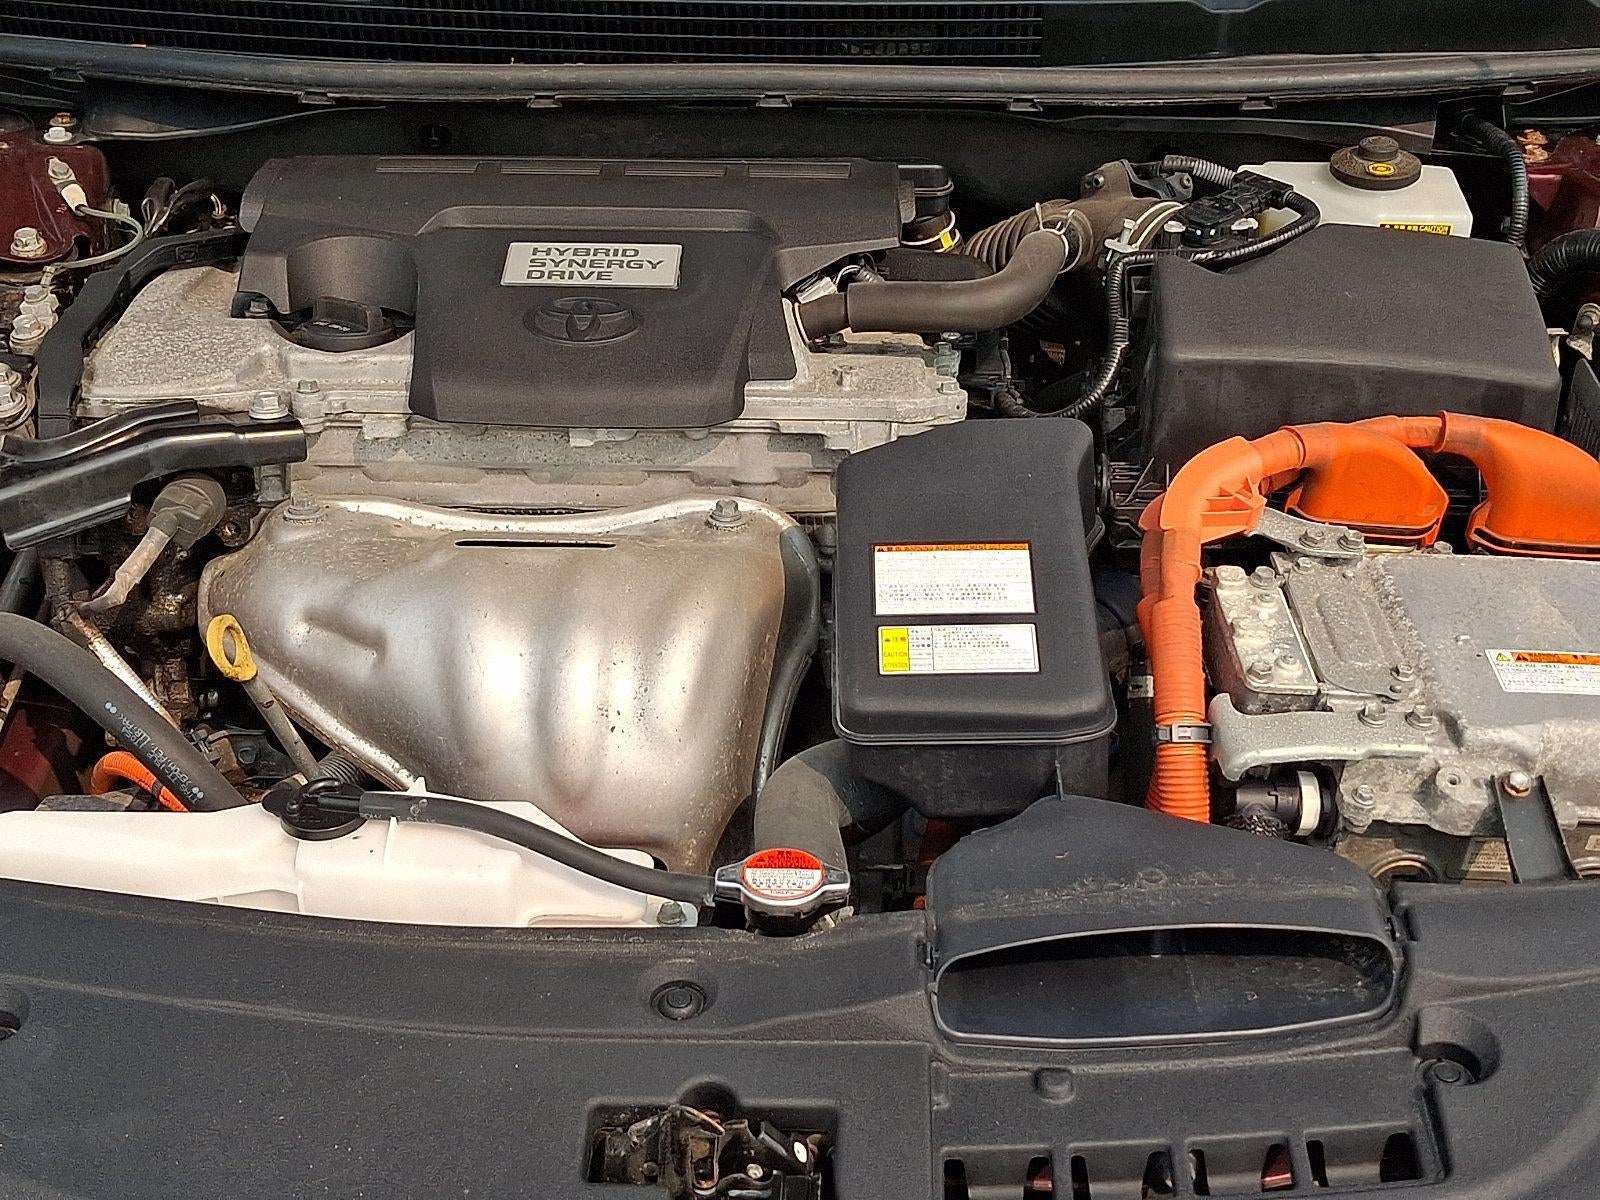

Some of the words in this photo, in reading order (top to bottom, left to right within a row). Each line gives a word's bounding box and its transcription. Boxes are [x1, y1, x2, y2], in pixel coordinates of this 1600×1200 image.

[531, 247, 640, 257] HYBRID
[528, 258, 665, 269] SYNERGY
[526, 270, 614, 281] DRIVE
